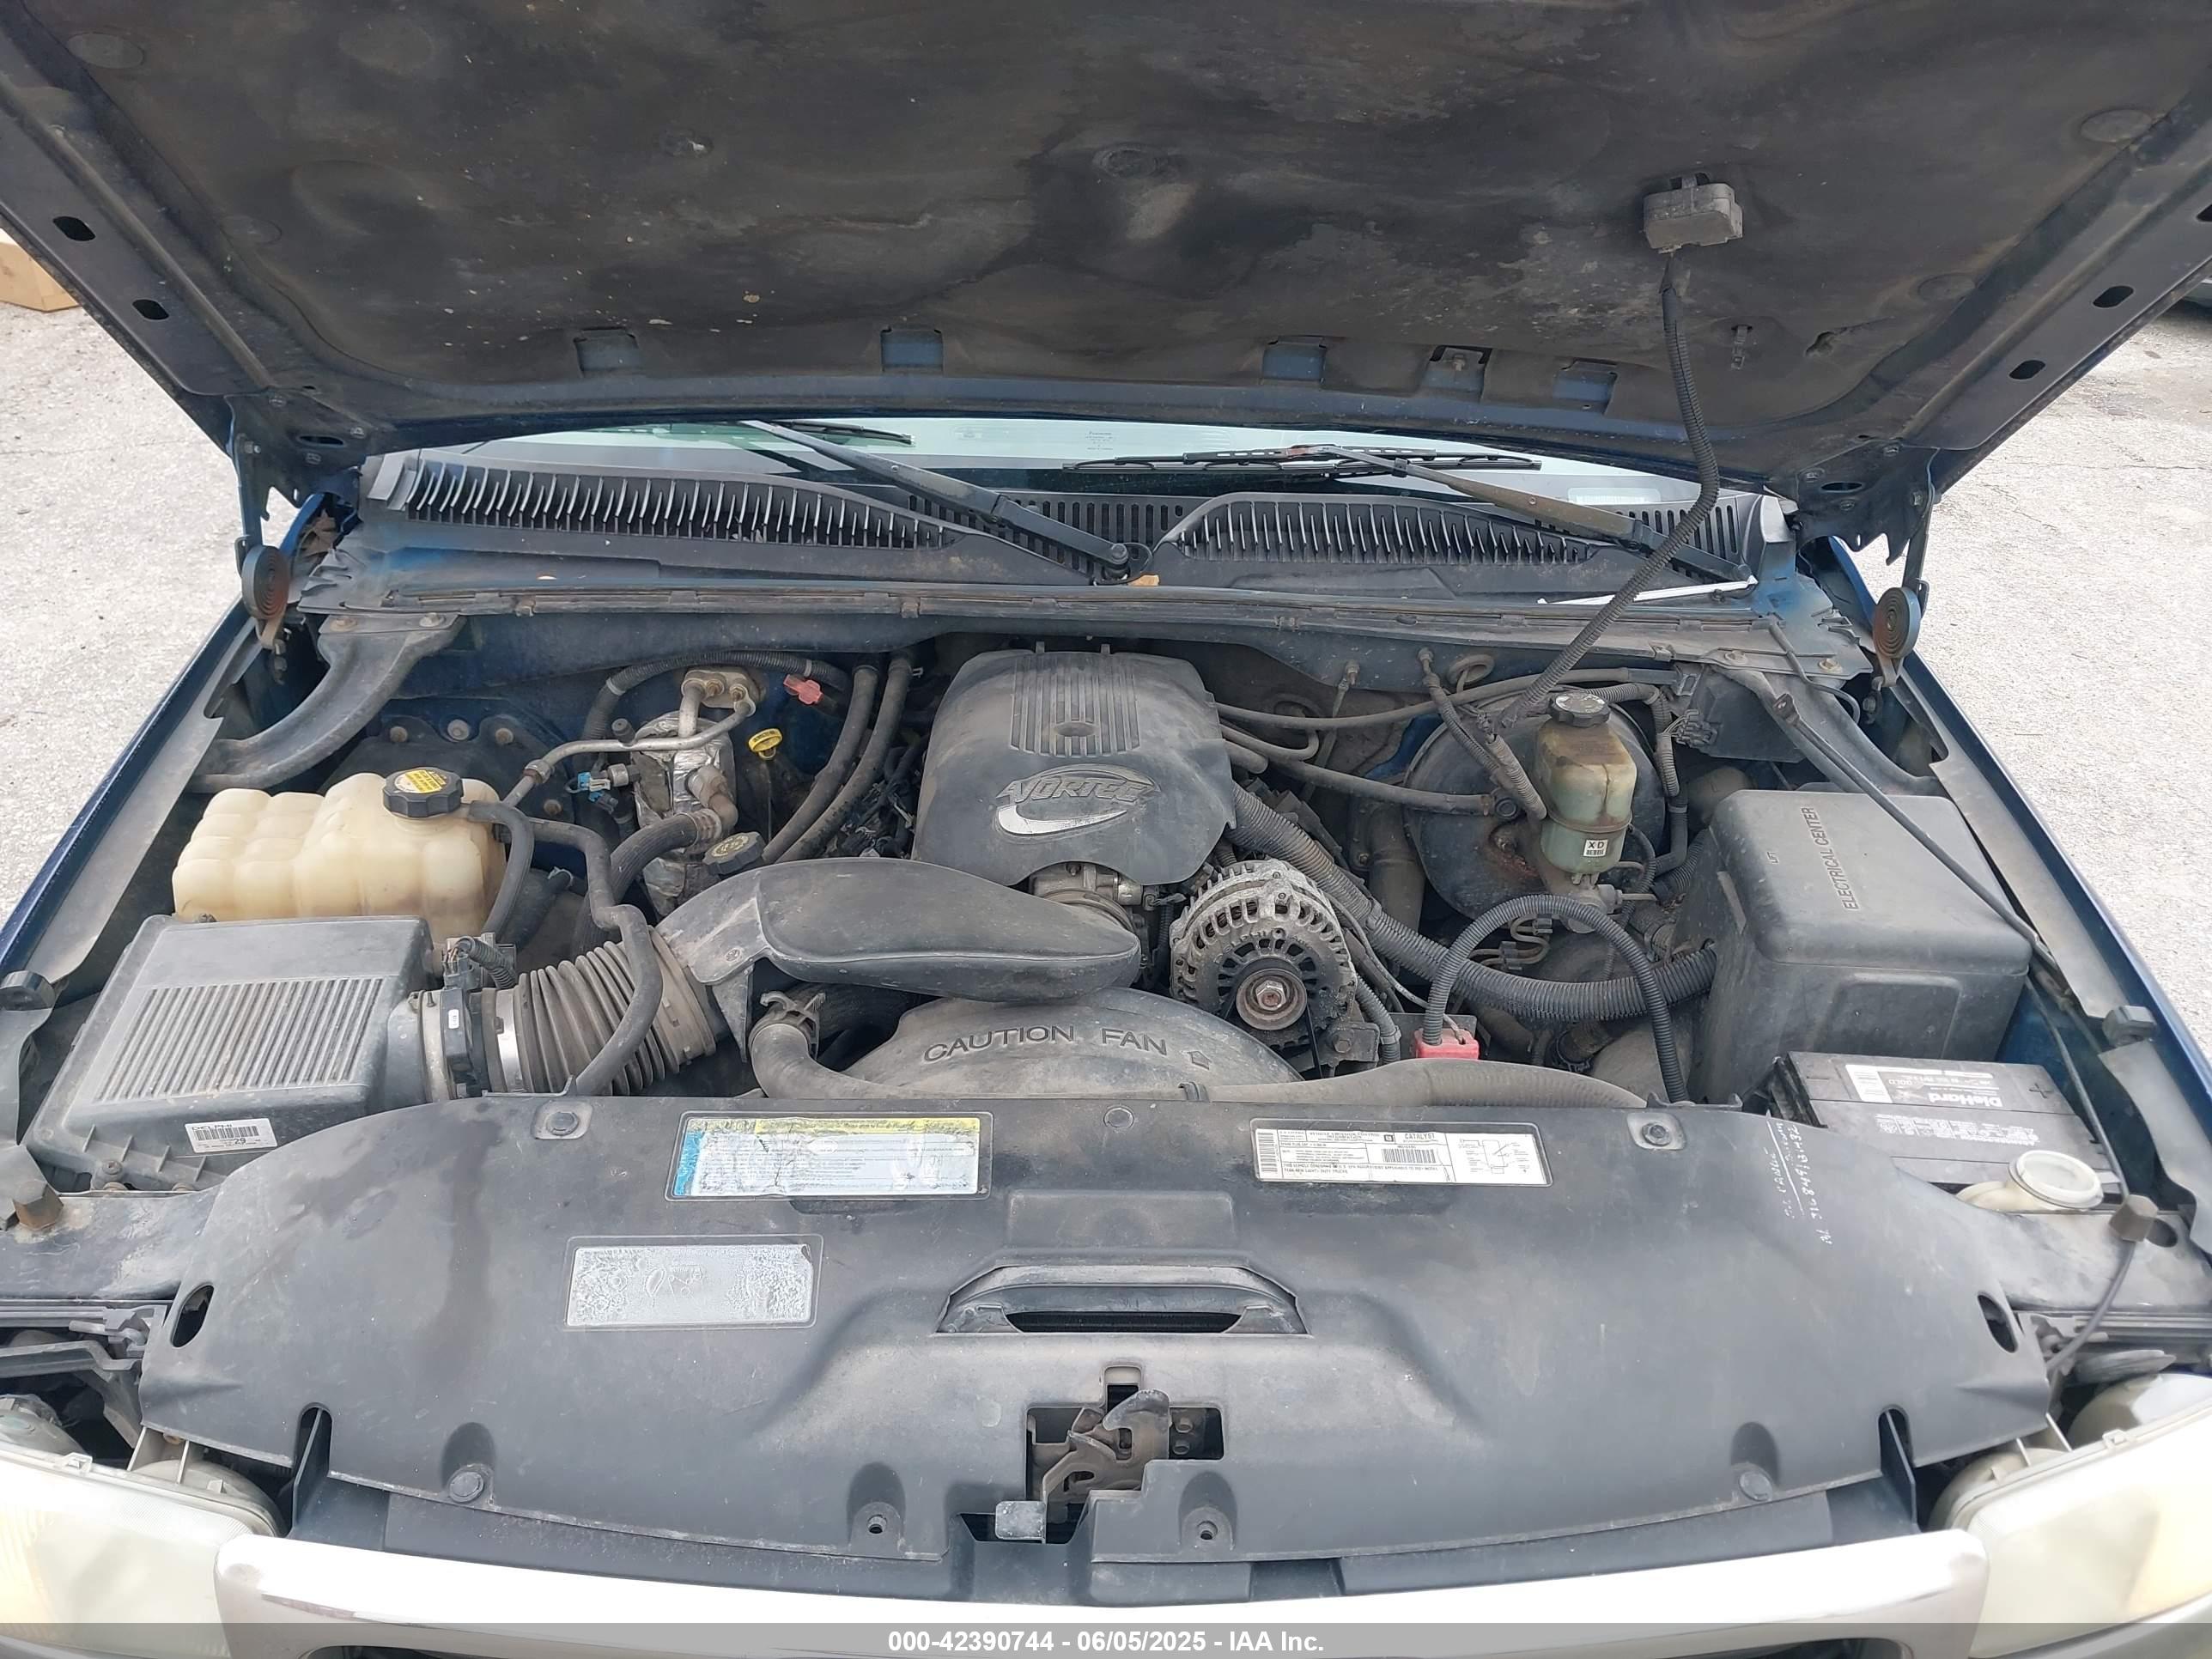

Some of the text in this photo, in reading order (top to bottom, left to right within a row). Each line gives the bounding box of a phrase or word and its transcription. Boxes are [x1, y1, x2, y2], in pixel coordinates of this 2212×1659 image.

[1000, 775, 1152, 805] VORTEC
[1801, 806, 1859, 910] ELECTRICAL CENTER
[922, 1025, 1168, 1063] CAUTION FAN
[1928, 1092, 2003, 1108] DieHard
